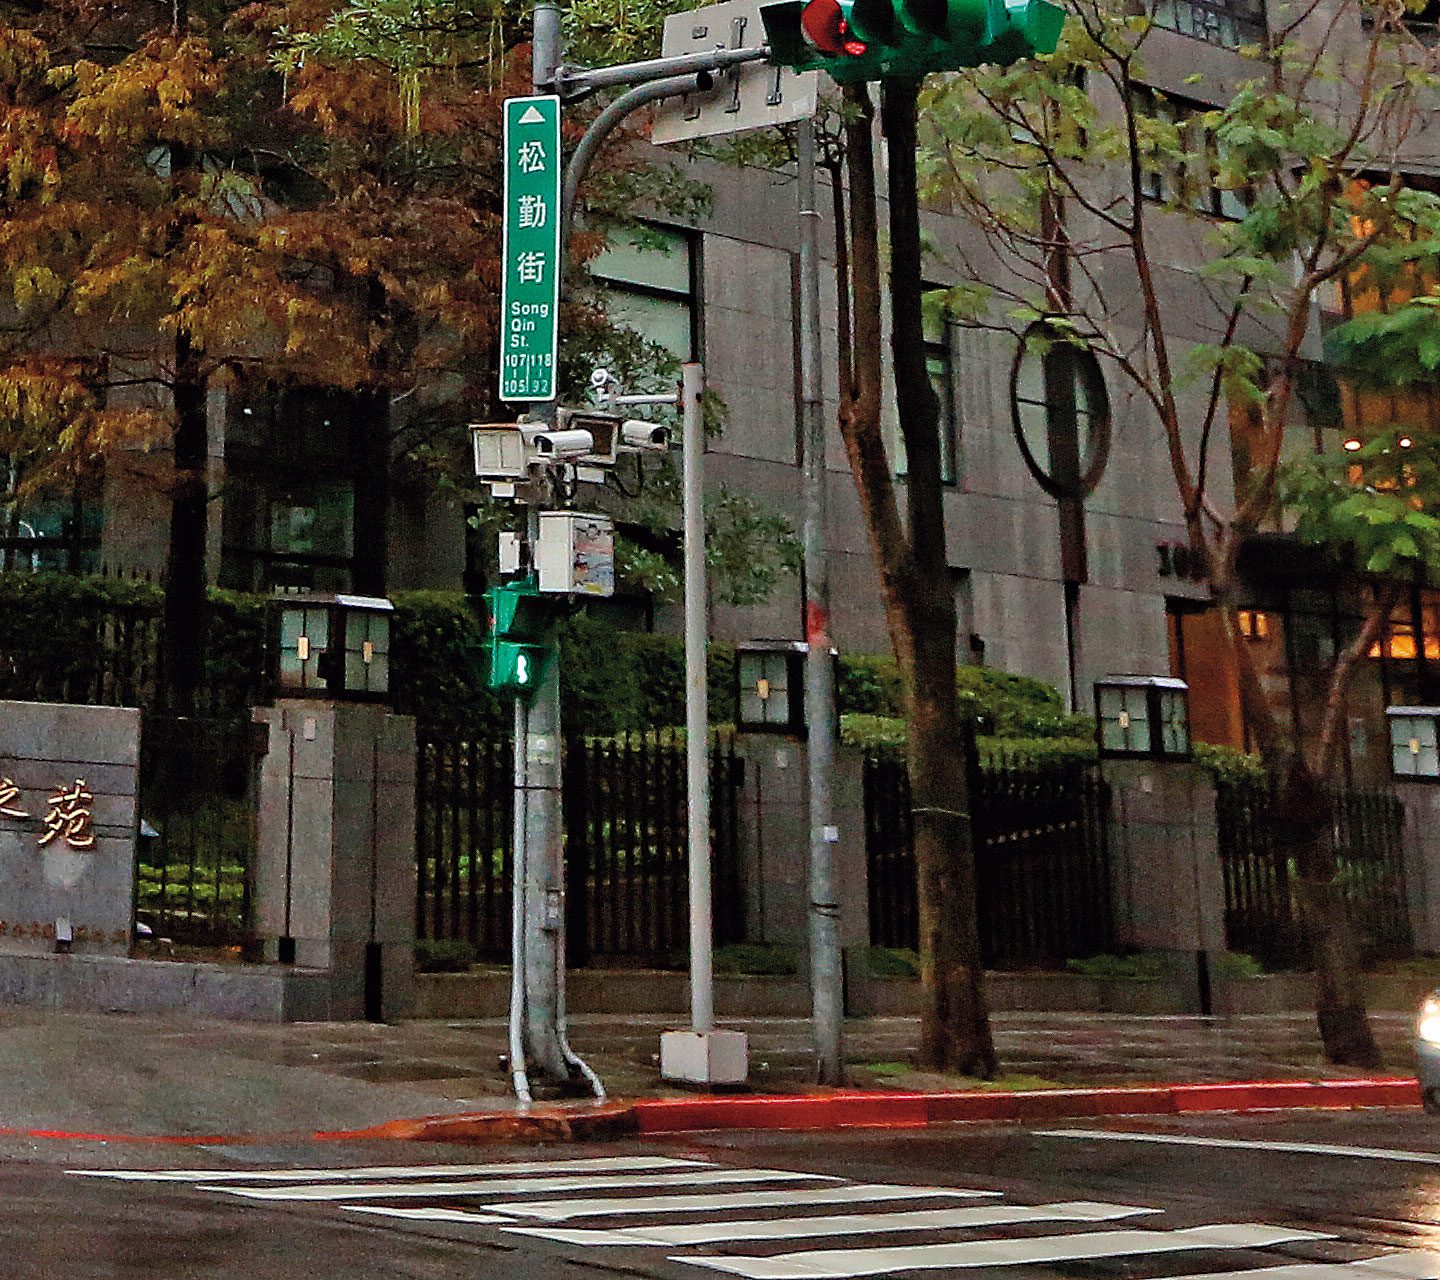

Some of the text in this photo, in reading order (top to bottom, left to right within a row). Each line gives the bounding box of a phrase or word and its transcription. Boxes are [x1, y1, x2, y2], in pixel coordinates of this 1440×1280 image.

[517, 141, 547, 284] 松勤街
[511, 301, 549, 318] Song
[511, 318, 536, 332] Qin
[510, 333, 529, 348] St.
[505, 353, 552, 368] 107 118
[504, 380, 526, 393] 105
